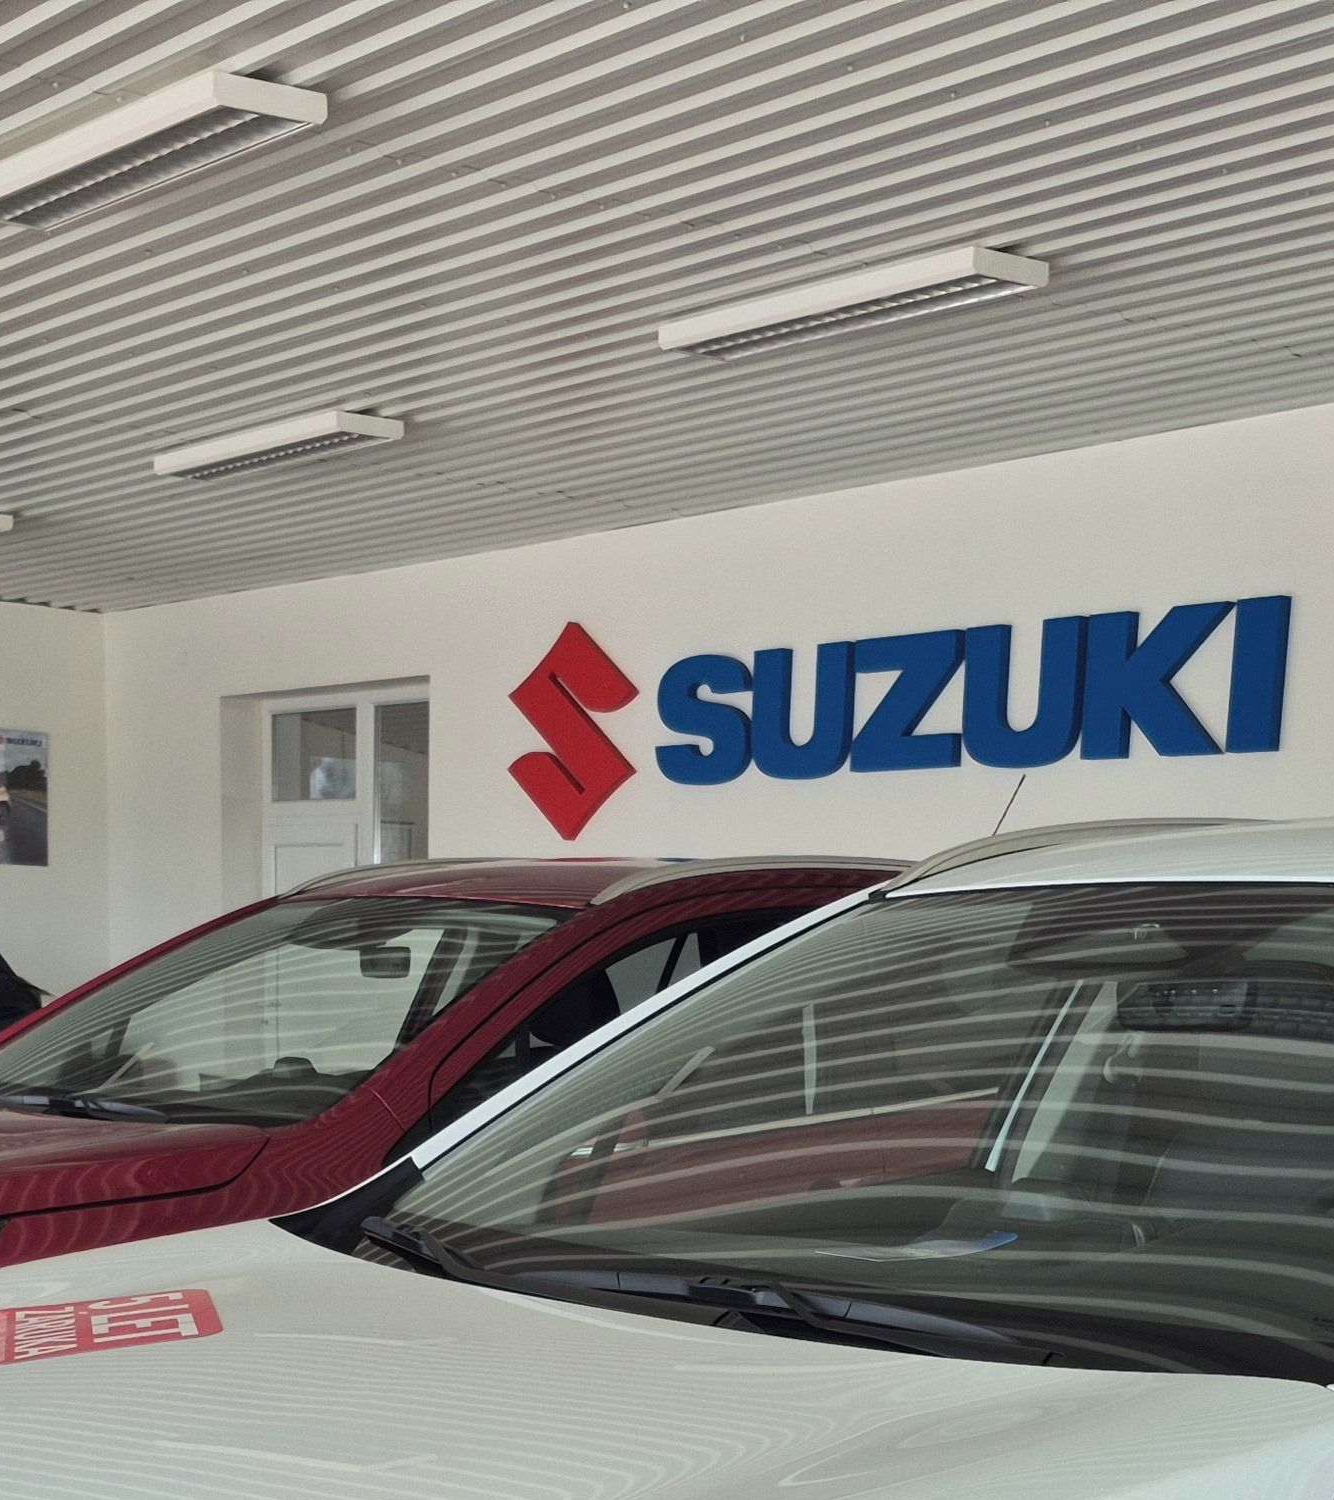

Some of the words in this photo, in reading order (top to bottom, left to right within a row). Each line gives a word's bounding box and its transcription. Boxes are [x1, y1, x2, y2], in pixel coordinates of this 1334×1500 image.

[655, 595, 1292, 785] SUZUKI
[88, 1290, 184, 1310] 5
[90, 1304, 199, 1343] LET
